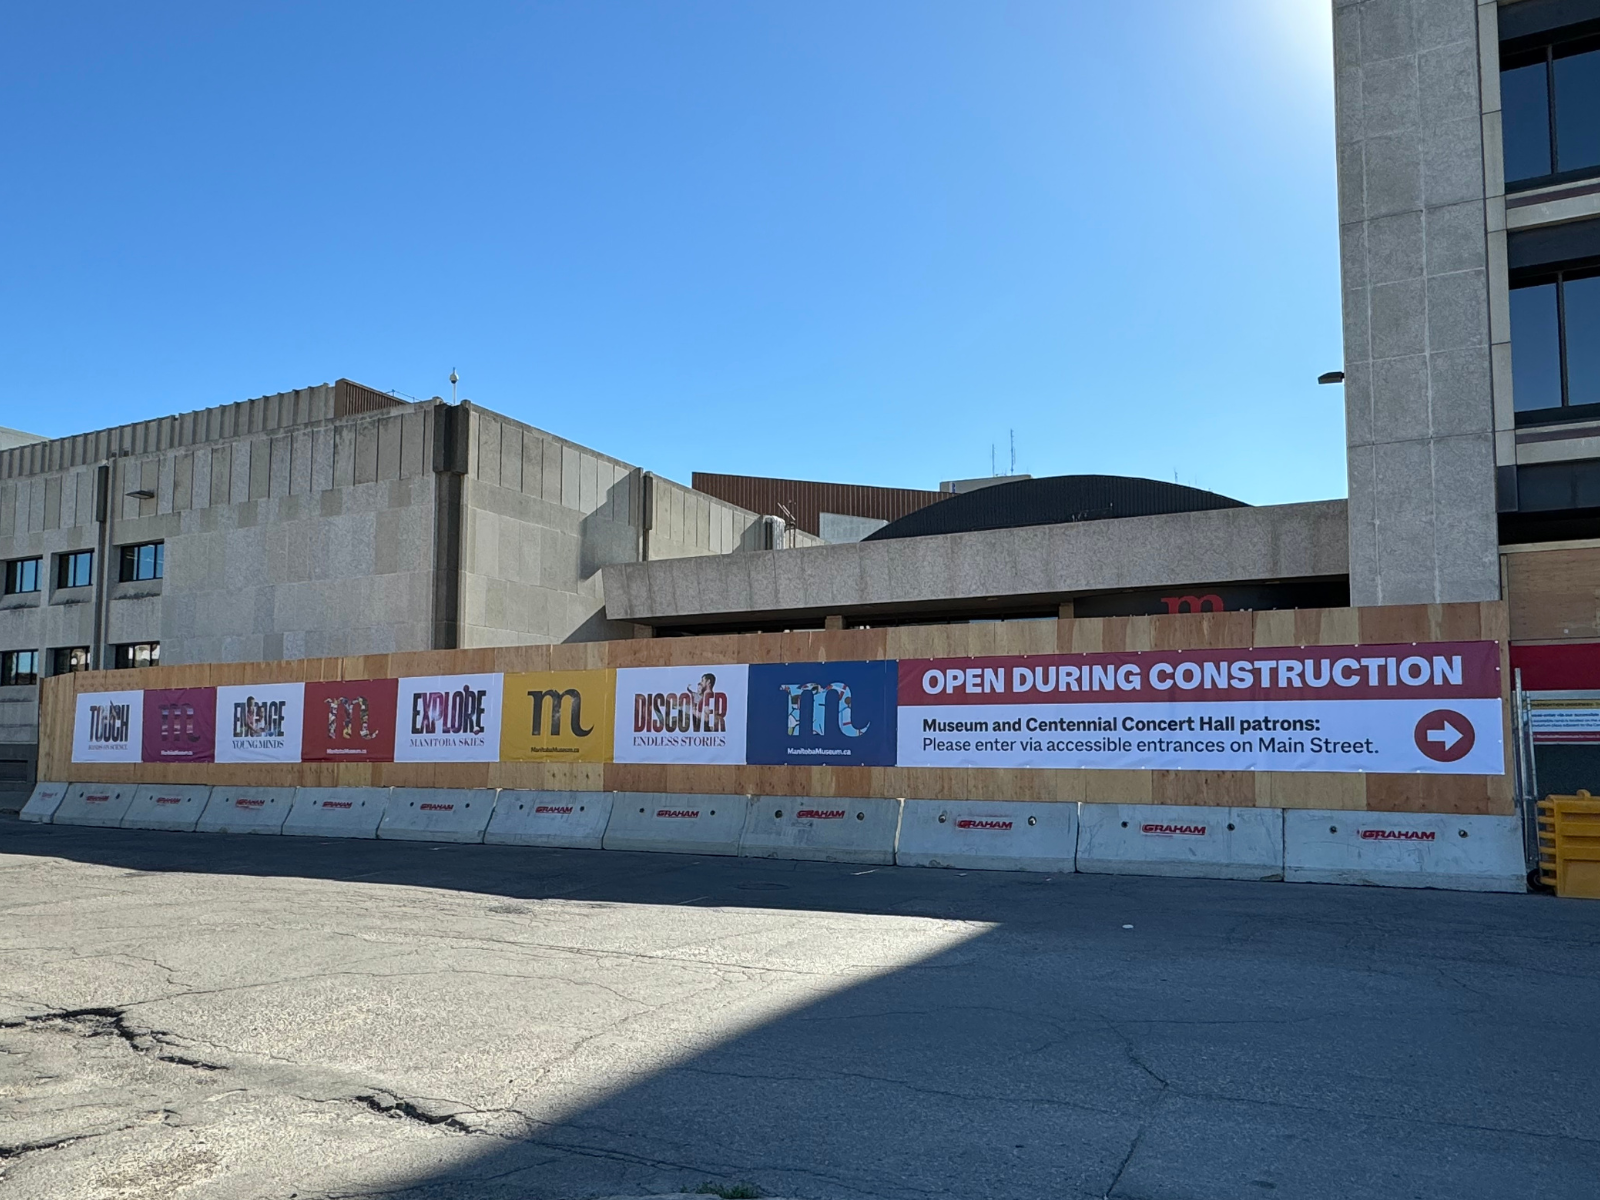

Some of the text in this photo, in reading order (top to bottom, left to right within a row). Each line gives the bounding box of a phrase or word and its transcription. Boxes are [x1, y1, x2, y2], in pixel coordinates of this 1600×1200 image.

[922, 655, 1463, 695] OPEN DURING CONSTRUCTION
[411, 689, 487, 735] EXPLORE
[527, 688, 595, 737] m
[633, 692, 728, 733] DISCOVER
[779, 682, 871, 737] m
[89, 704, 130, 743] TOUCH
[324, 696, 379, 740] m
[922, 716, 1321, 735] Museum and Centennial Concert Hall patrons:
[232, 739, 284, 749] YOUNG MINDS
[409, 737, 485, 747] MANITOBA SKIES
[633, 736, 726, 747] ENDLESS STORIES
[922, 736, 1379, 754] Please enter via accessible entrances on Main Street.
[787, 747, 852, 756] ManitobaMuseum.ca
[420, 803, 454, 812] GRAHAM
[535, 806, 573, 815] GRAHAM
[656, 809, 700, 819] GRAHAM
[796, 809, 845, 819] GRAHAM
[957, 819, 1013, 829] GRAHAM
[1142, 823, 1206, 835] GRAHAM
[1360, 829, 1435, 840] GRAHAM
